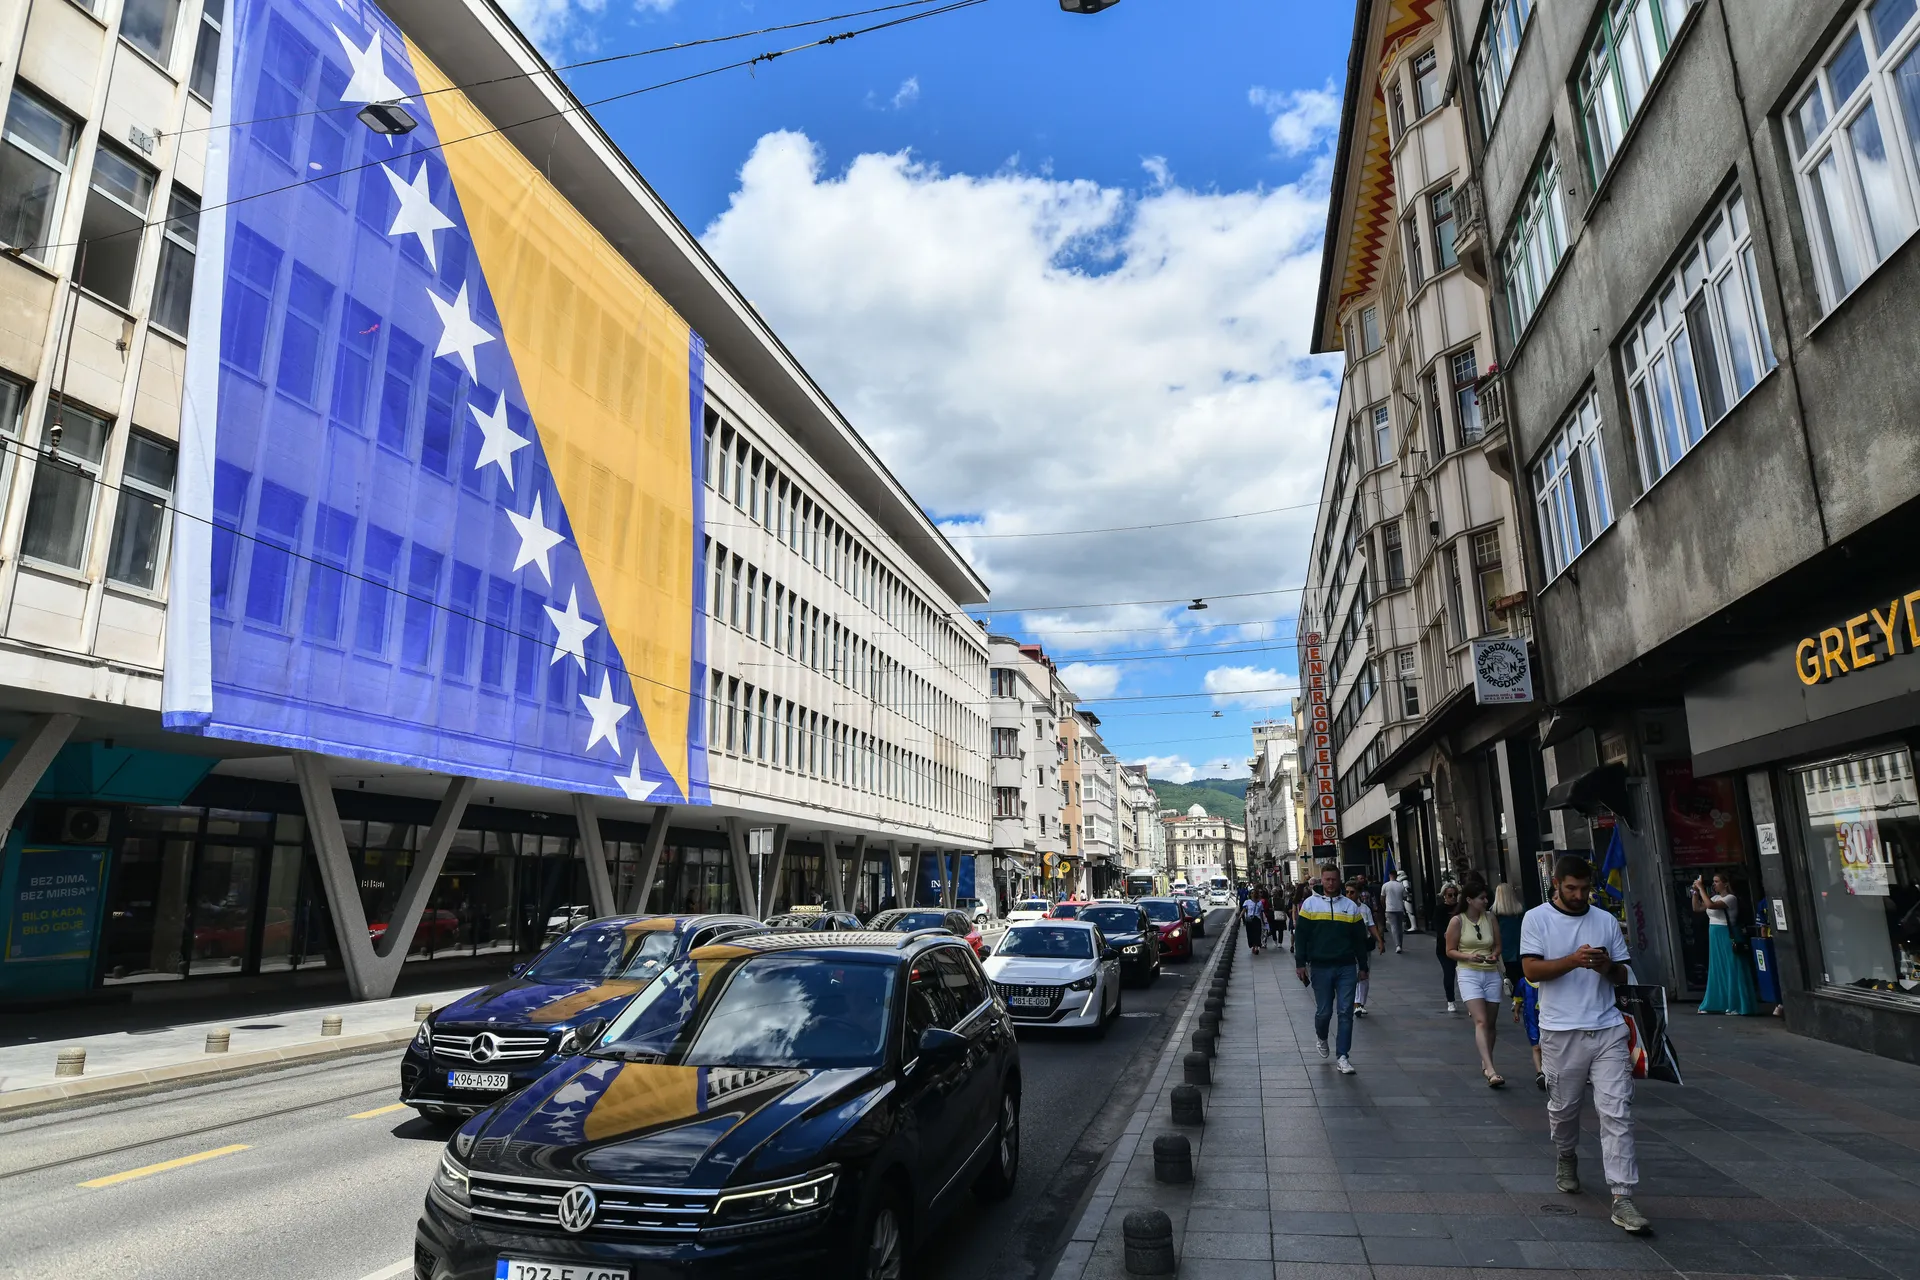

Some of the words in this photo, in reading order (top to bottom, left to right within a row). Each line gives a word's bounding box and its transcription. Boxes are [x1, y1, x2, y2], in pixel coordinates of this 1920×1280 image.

[1309, 647, 1334, 823] ENERGOPETROL
[30, 876, 54, 887] BEZ
[56, 874, 88, 884] DIMA,
[20, 890, 44, 901] BEZ
[21, 910, 49, 922] BILO
[22, 924, 50, 935] BILO
[52, 920, 84, 932] GDJE
[454, 1073, 506, 1087] K96-A-939
